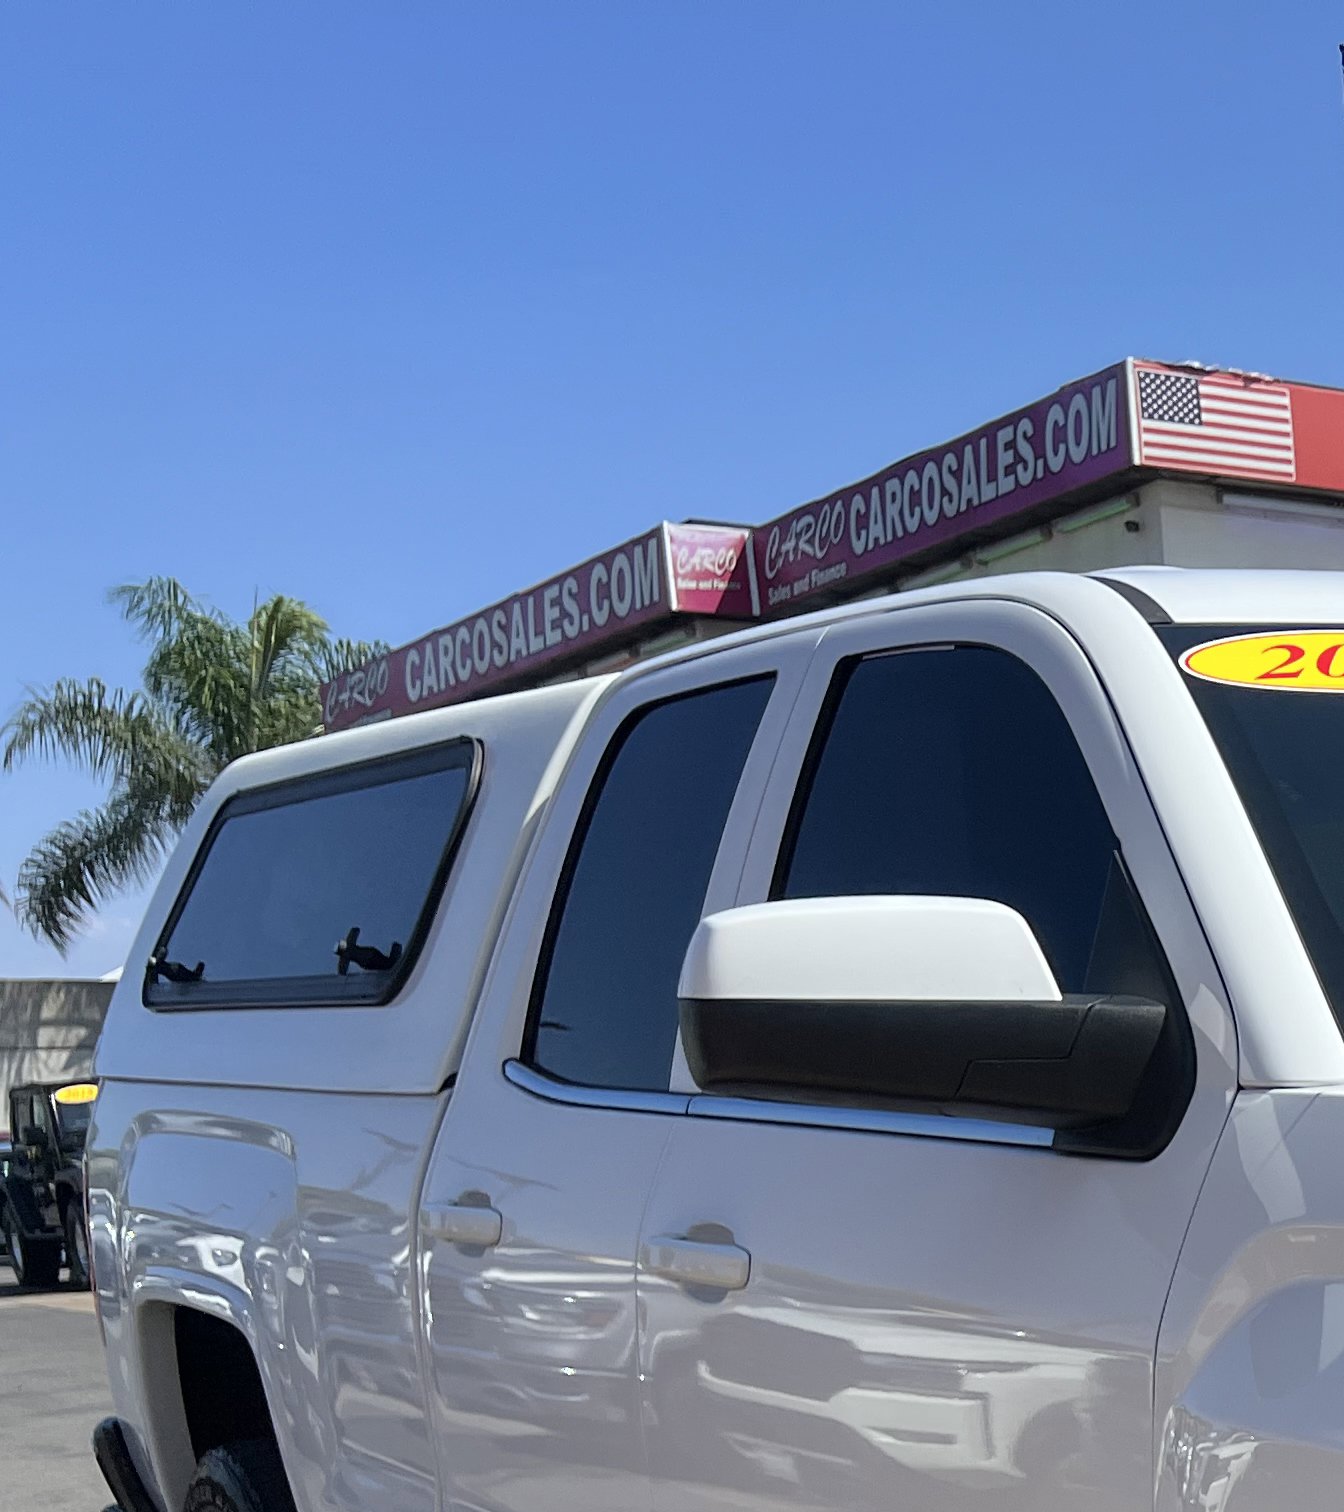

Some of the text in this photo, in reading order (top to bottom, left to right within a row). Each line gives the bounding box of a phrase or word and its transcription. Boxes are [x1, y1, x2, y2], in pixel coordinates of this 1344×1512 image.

[849, 377, 1117, 556] CARCOSALES.COM
[676, 546, 737, 577] CARCO
[765, 499, 845, 579] CARCO
[404, 537, 661, 703] CARCOSALES.COM
